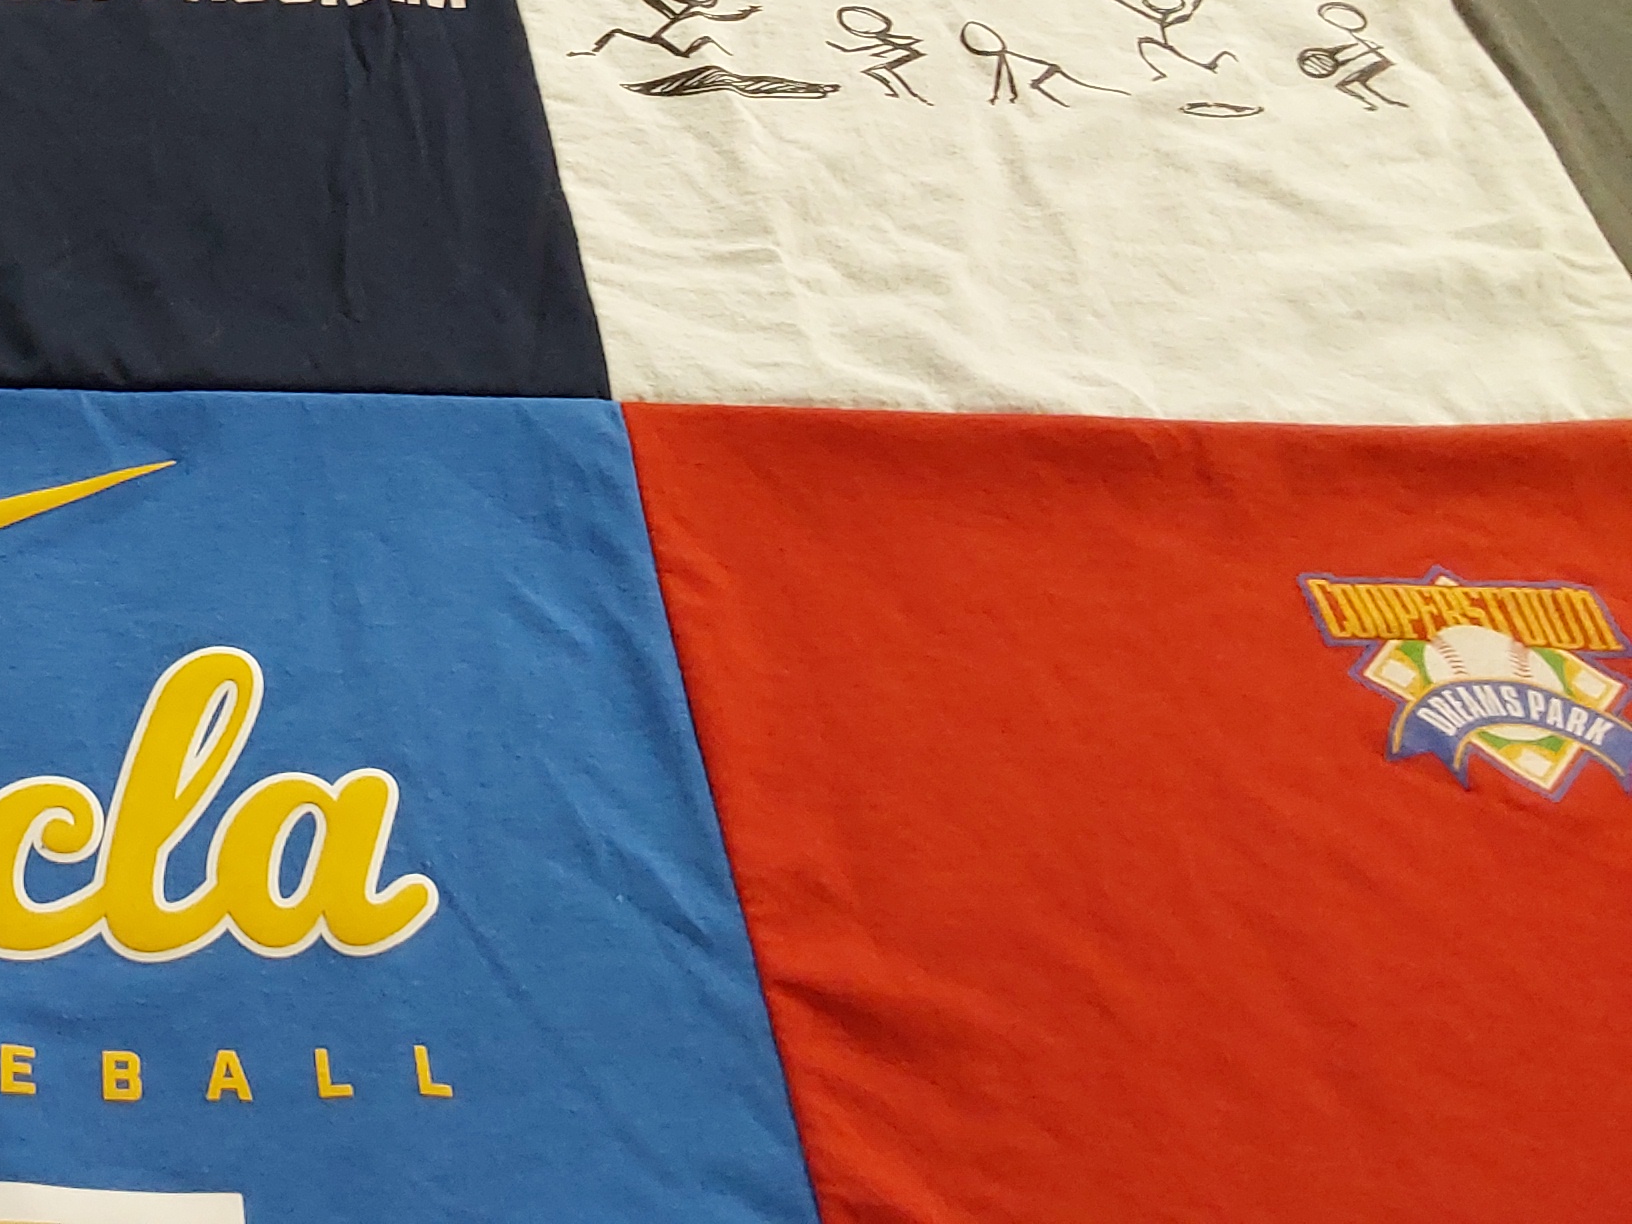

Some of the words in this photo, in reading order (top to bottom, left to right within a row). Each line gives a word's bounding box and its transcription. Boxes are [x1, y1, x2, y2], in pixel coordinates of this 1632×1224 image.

[1306, 579, 1623, 652] COOPERSTOWN
[1416, 684, 1525, 737] DREAMS
[1527, 688, 1615, 746] PARK
